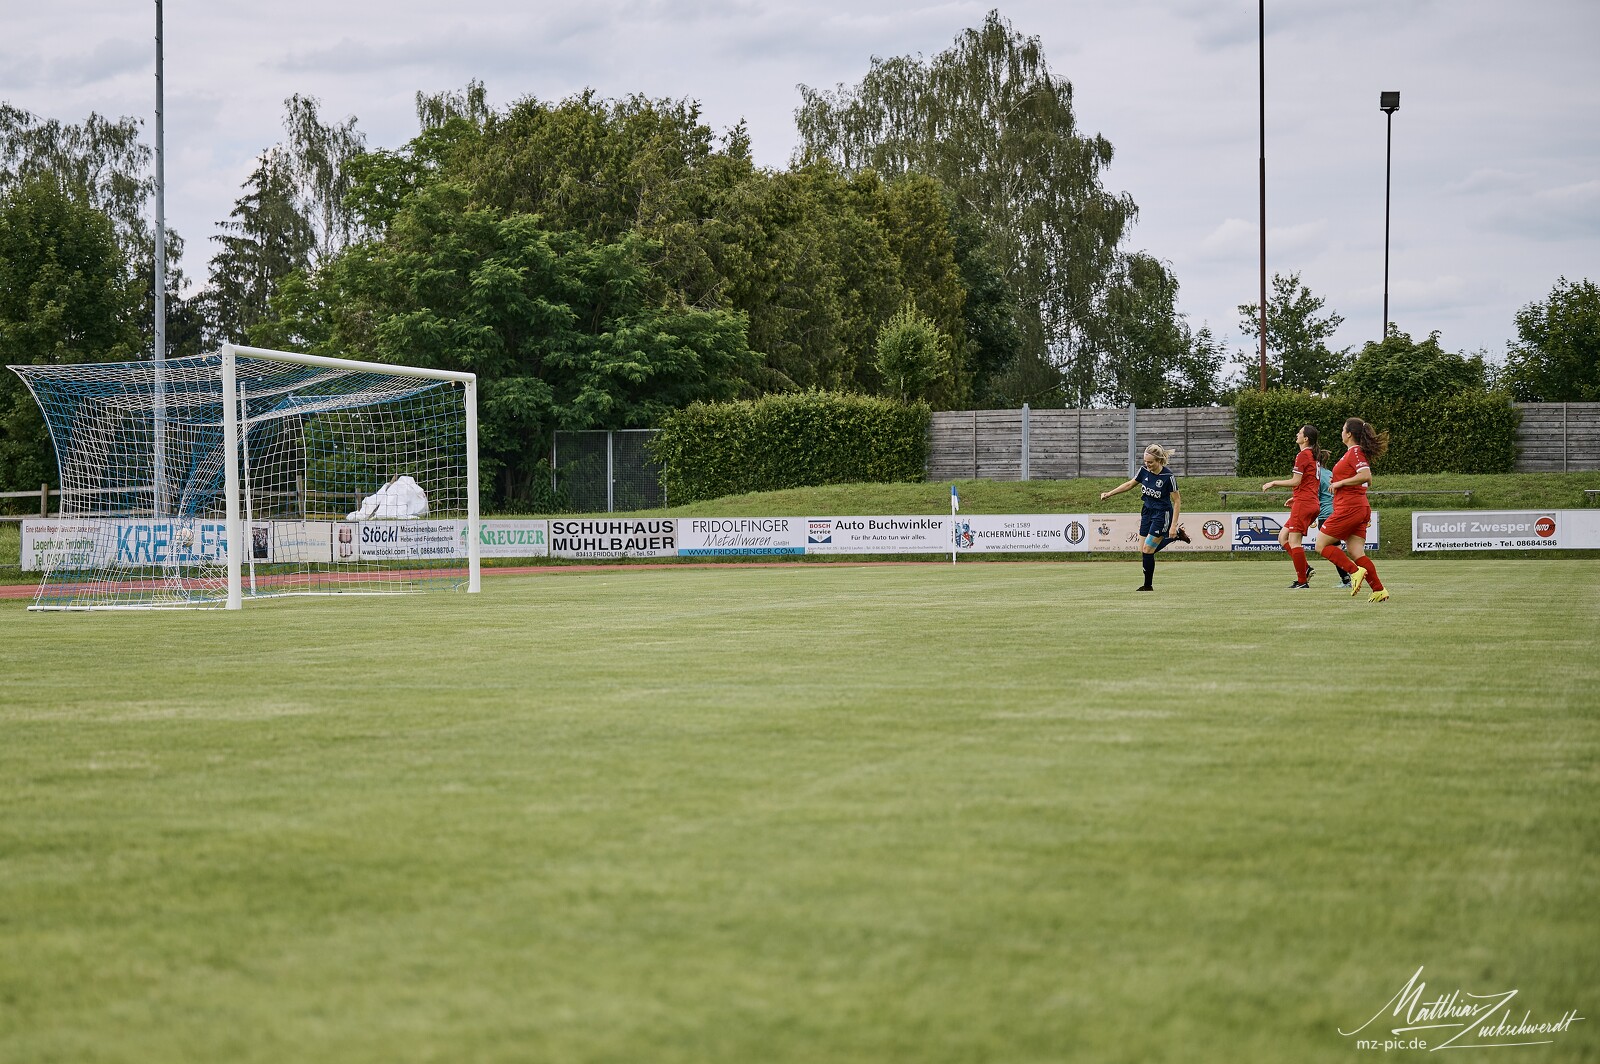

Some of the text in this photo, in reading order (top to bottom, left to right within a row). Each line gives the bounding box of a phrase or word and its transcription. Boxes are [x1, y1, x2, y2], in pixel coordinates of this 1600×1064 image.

[400, 525, 437, 533] Maschinenbau
[552, 520, 674, 535] SCHUHHAUS
[692, 519, 789, 533] FRIDOLFINGER
[835, 518, 943, 530] Auto Buchwinkler
[1422, 522, 1531, 534] Rudolf Zwesper
[362, 525, 399, 543] Stöckl
[978, 530, 1031, 538] AICHERMÜHLE
[552, 535, 675, 551] MÜHLBAUER
[702, 534, 772, 547] Metallwaren
[1417, 540, 1493, 549] KFZ-Meisterbetrieb
[687, 547, 796, 556] WWW.FRIDOLFINGER.COM
